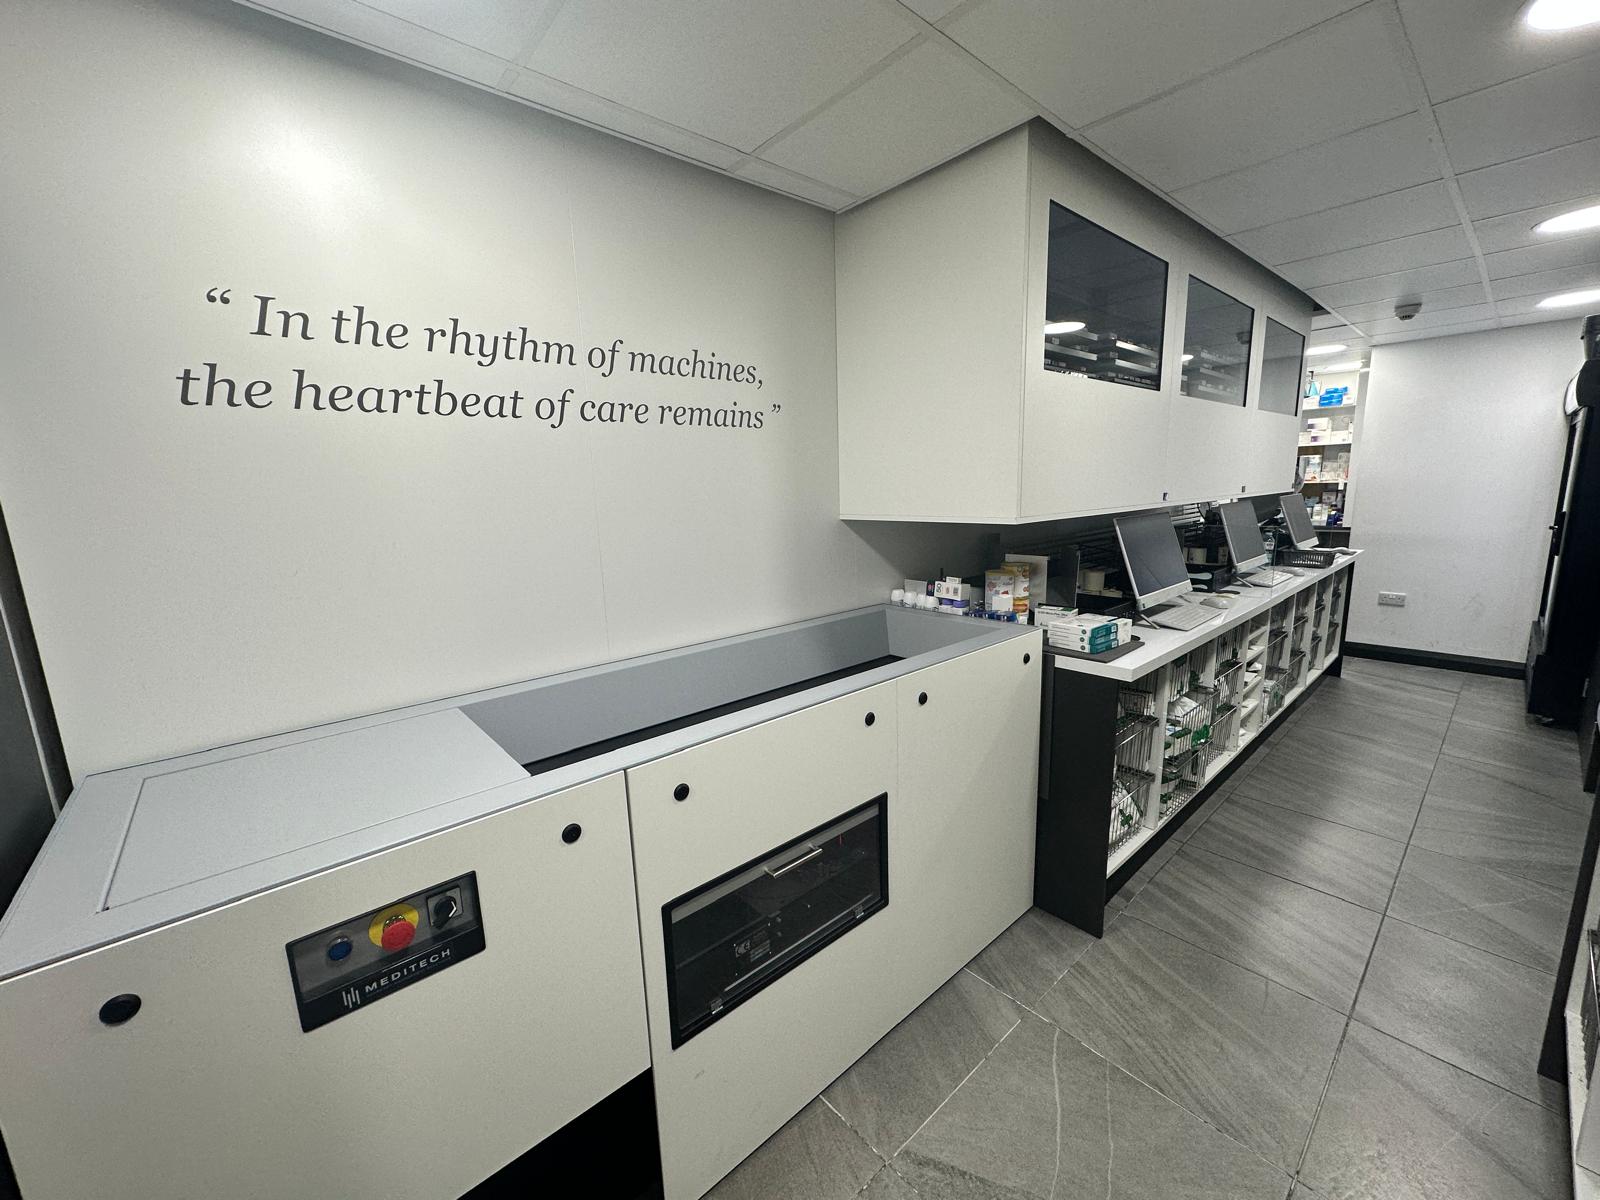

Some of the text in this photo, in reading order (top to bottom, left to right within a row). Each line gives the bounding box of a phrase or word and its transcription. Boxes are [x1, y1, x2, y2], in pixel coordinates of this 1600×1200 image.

[249, 294, 315, 341] In
[330, 305, 409, 350] the
[423, 317, 577, 370] rhythm
[587, 338, 624, 378] of
[627, 351, 763, 390] machines,
[175, 362, 273, 409] the
[291, 368, 525, 421] heartbeat
[534, 388, 575, 429] of
[579, 400, 649, 425] care
[657, 400, 764, 430] remains
[364, 947, 451, 994] MEDITECH
